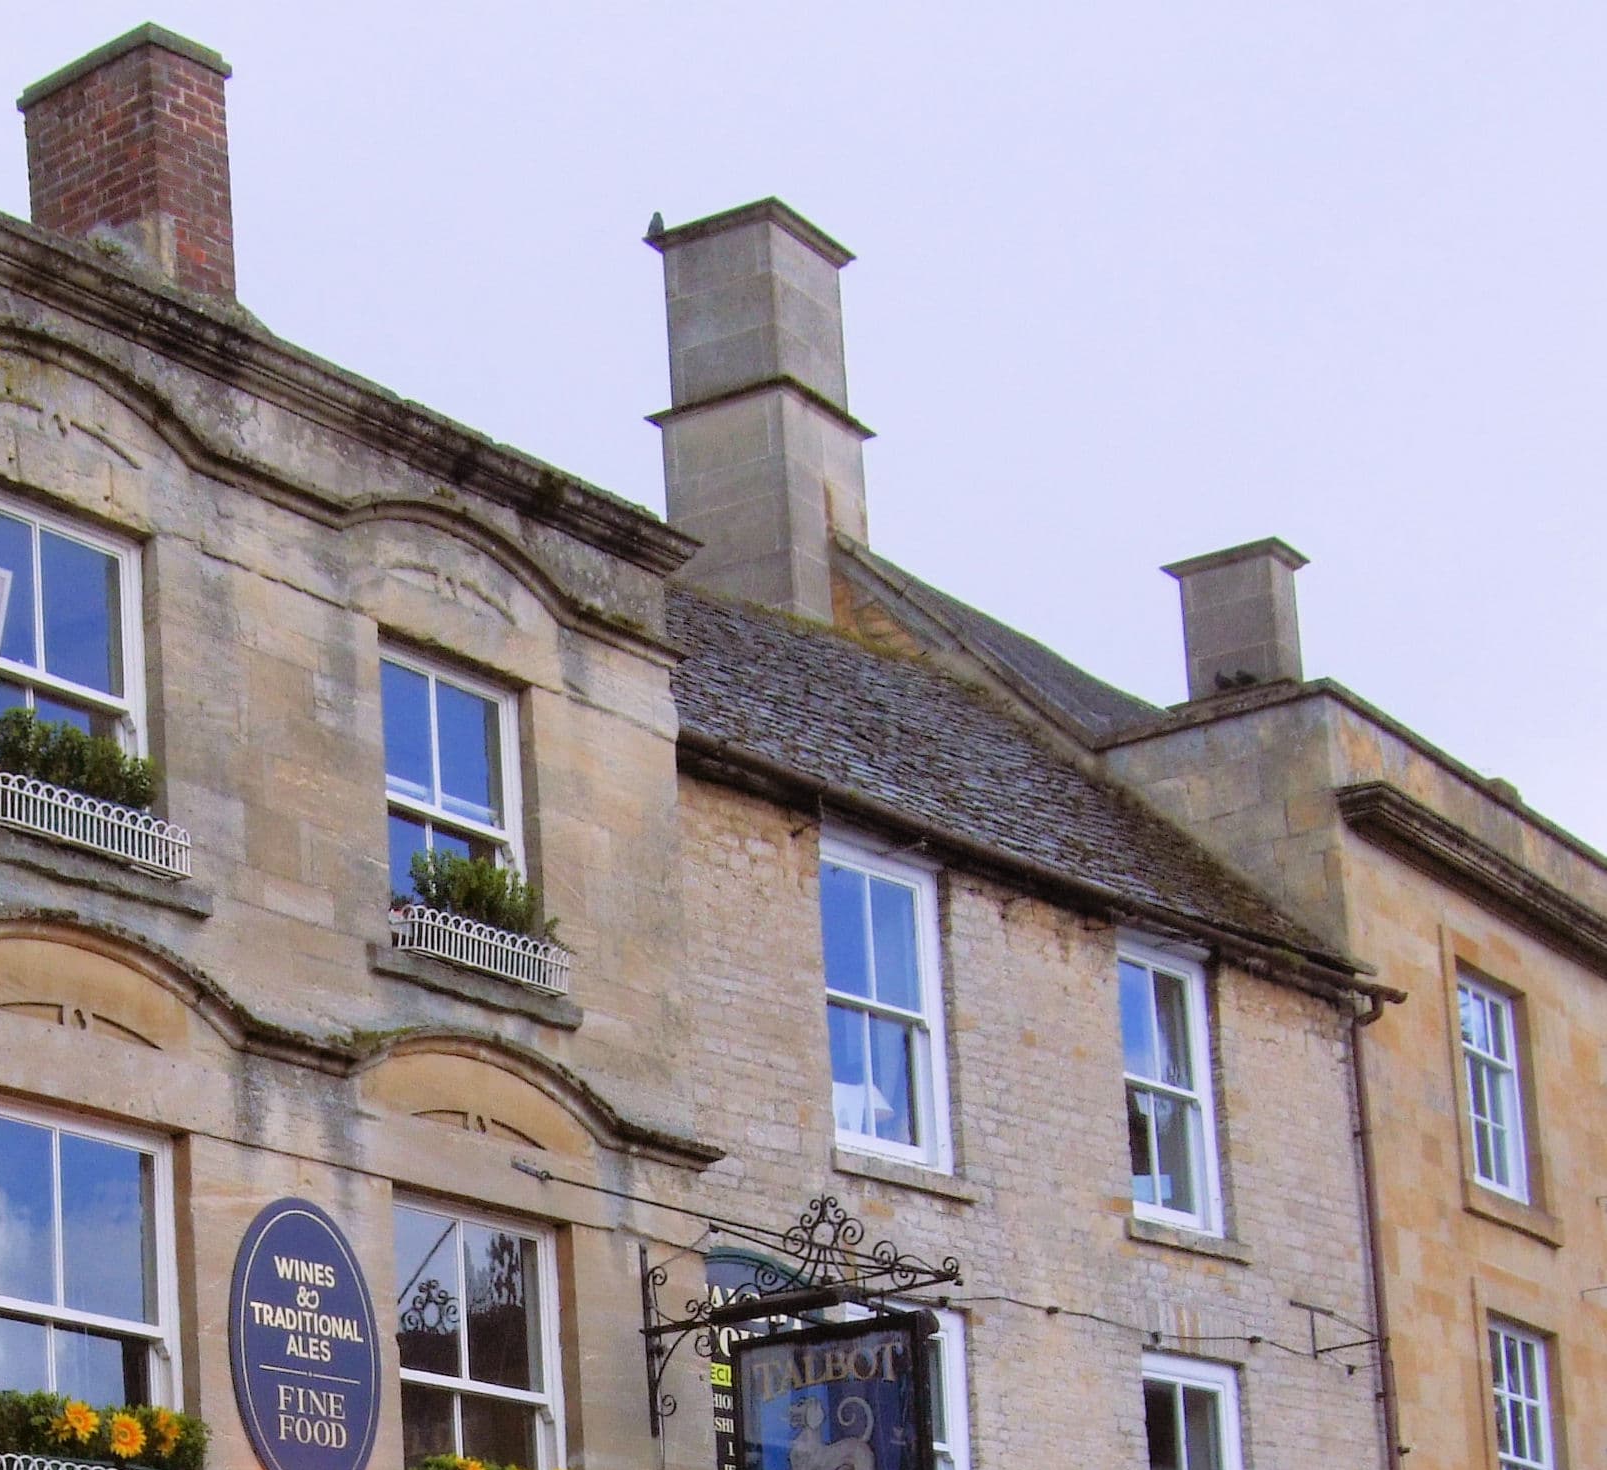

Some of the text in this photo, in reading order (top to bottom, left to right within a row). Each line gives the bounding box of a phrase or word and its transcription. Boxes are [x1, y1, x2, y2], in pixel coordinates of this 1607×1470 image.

[274, 1255, 335, 1288] WINES
[296, 1285, 319, 1310] &
[250, 1301, 364, 1343] TRADITIONAL
[286, 1334, 332, 1362] ALES
[754, 1342, 903, 1400] TALBOT
[278, 1384, 346, 1420] FINE
[279, 1414, 347, 1449] FOOD
